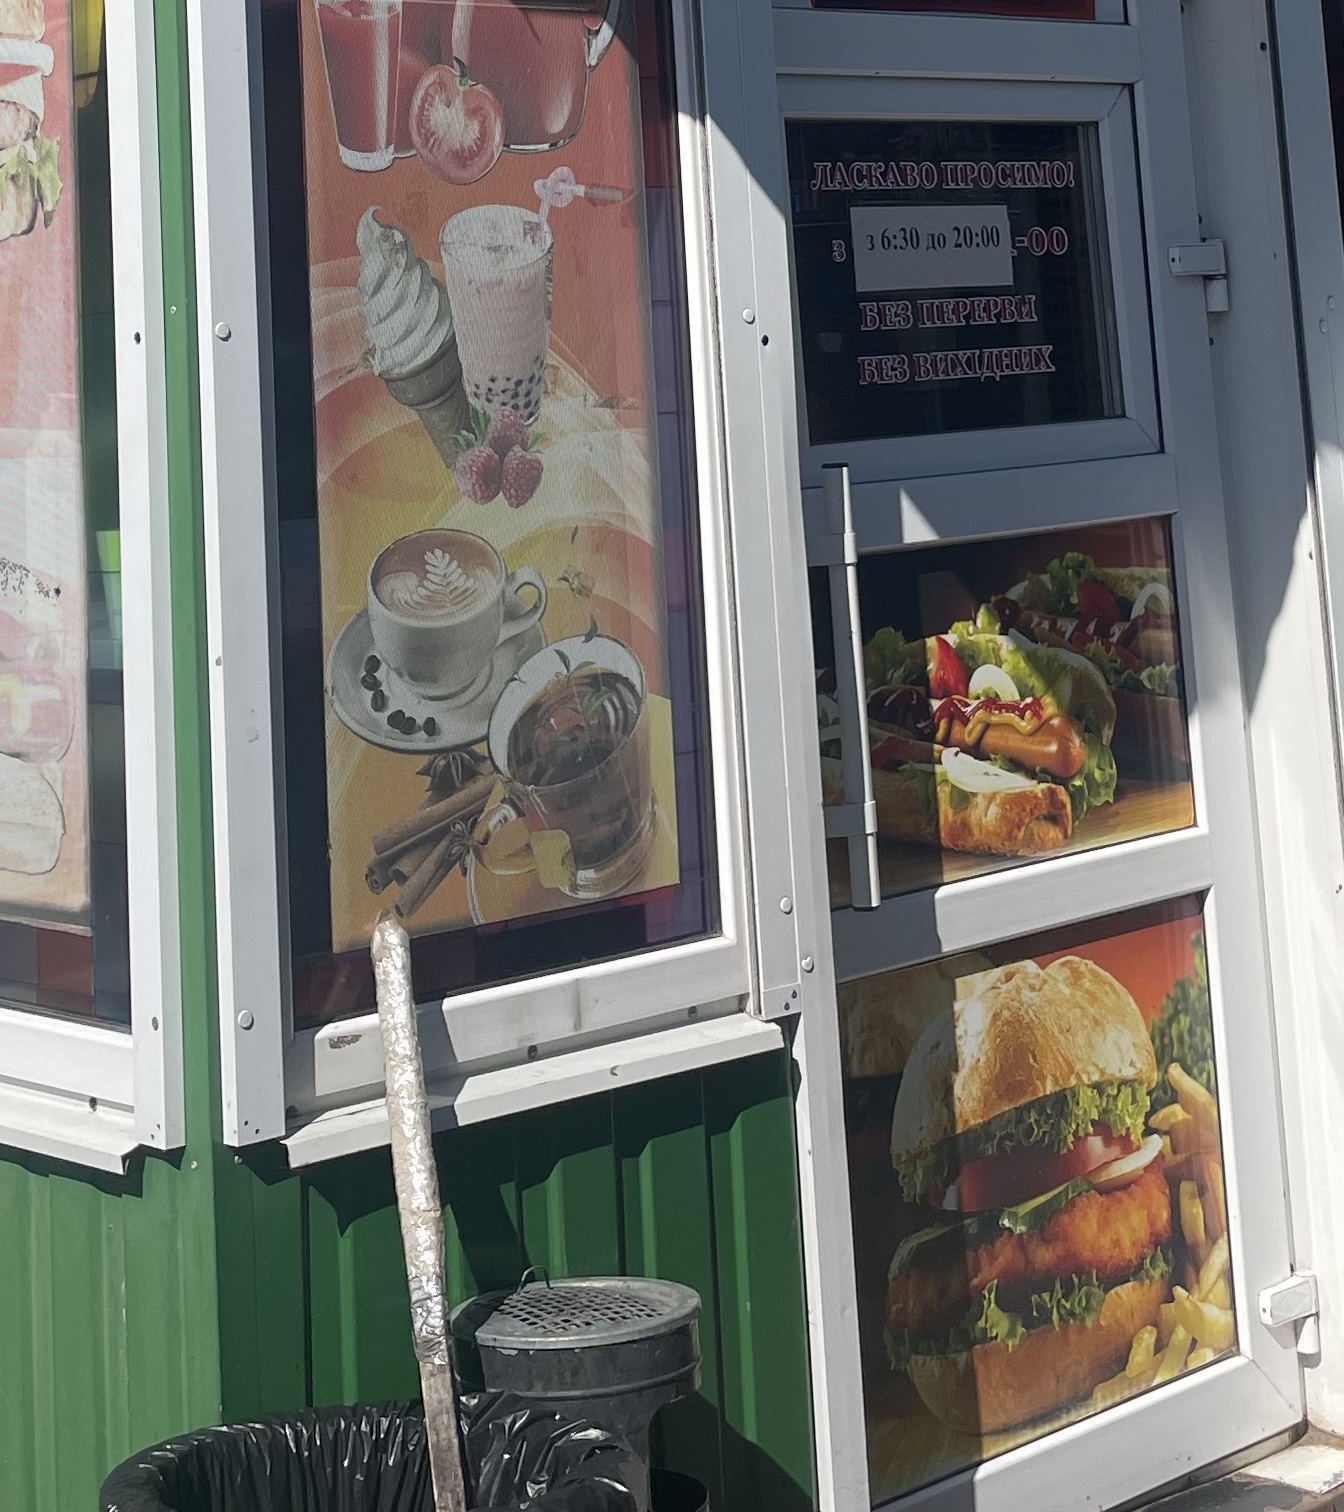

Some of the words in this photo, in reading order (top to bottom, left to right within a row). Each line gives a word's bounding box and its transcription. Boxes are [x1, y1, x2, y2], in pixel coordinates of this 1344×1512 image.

[810, 161, 938, 190] ЛАСКАВО
[941, 160, 1076, 189] ПРОСИМО!
[880, 227, 920, 251] 6:30
[925, 232, 947, 252] до
[952, 225, 1001, 249] 20:00
[859, 300, 913, 331] БЕЗ
[917, 294, 1038, 328] ПЕРЕРВИ
[857, 354, 910, 385] БЕЗ
[912, 345, 1056, 383] ВИХІДНИХ
